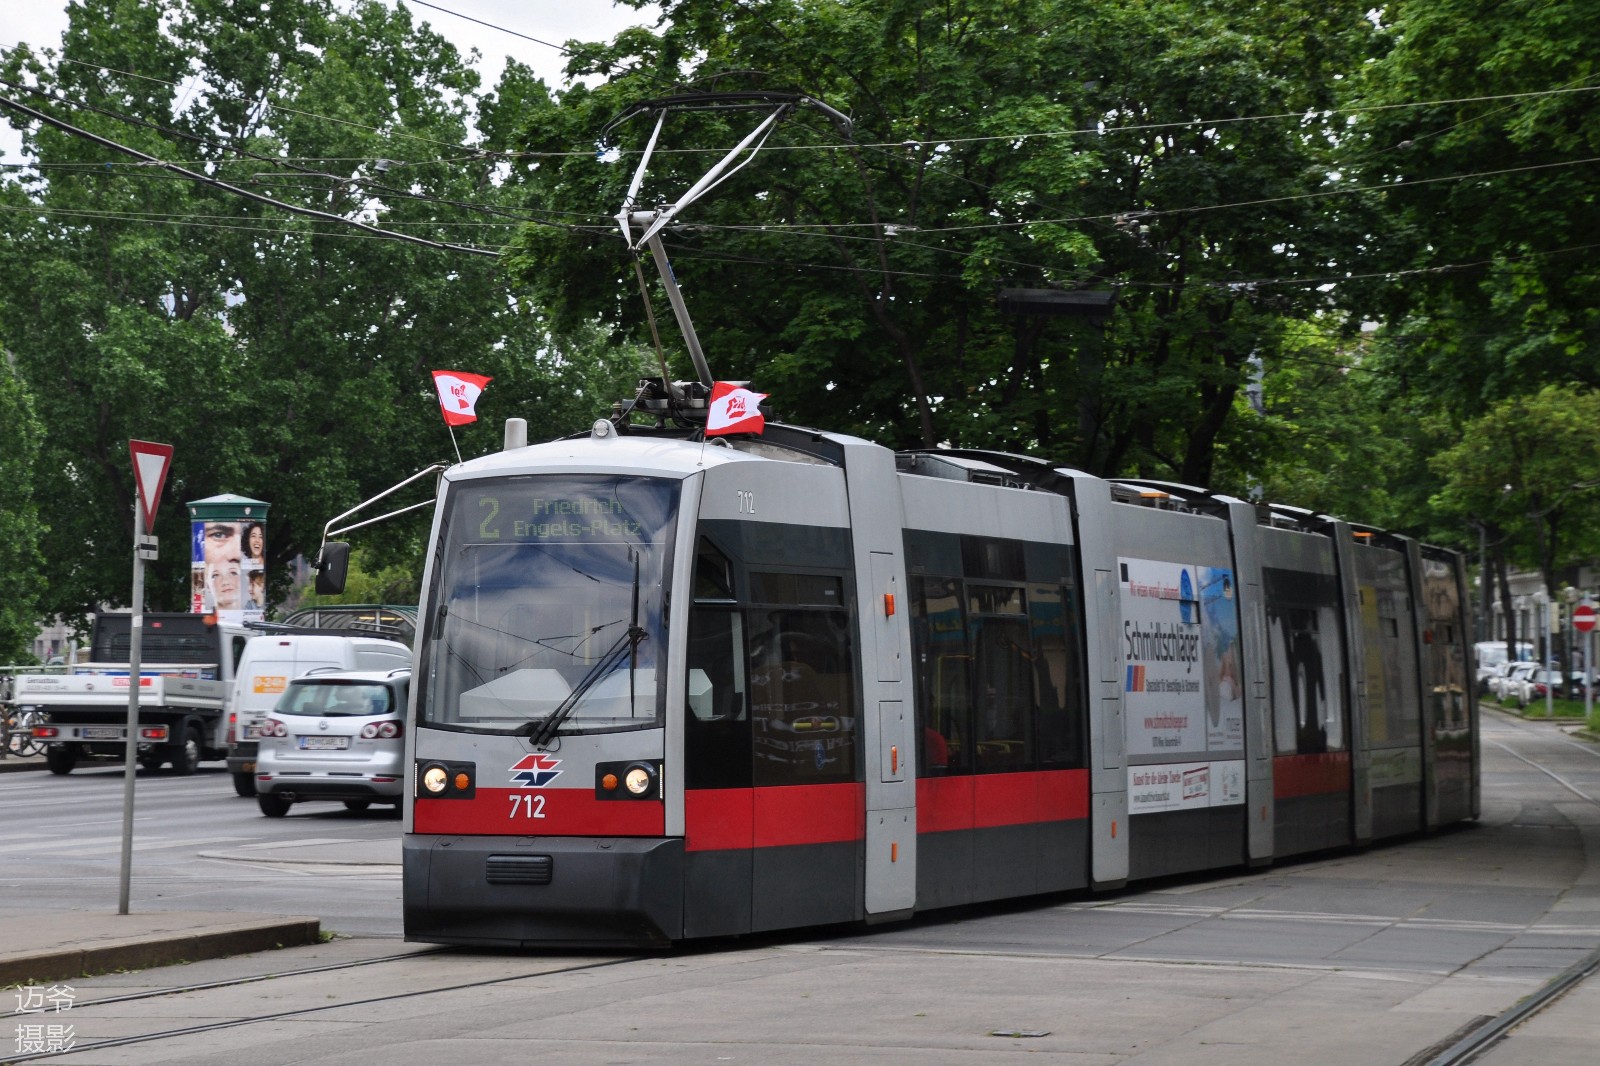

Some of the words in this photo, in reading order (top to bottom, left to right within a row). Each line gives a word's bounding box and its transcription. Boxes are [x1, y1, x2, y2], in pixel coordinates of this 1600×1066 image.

[533, 498, 622, 515] Friedrich
[737, 490, 755, 514] 712
[479, 498, 500, 539] 2
[513, 520, 641, 538] Engels-Platz
[1124, 620, 1199, 674] Schmidtschläger
[509, 794, 546, 818] 712
